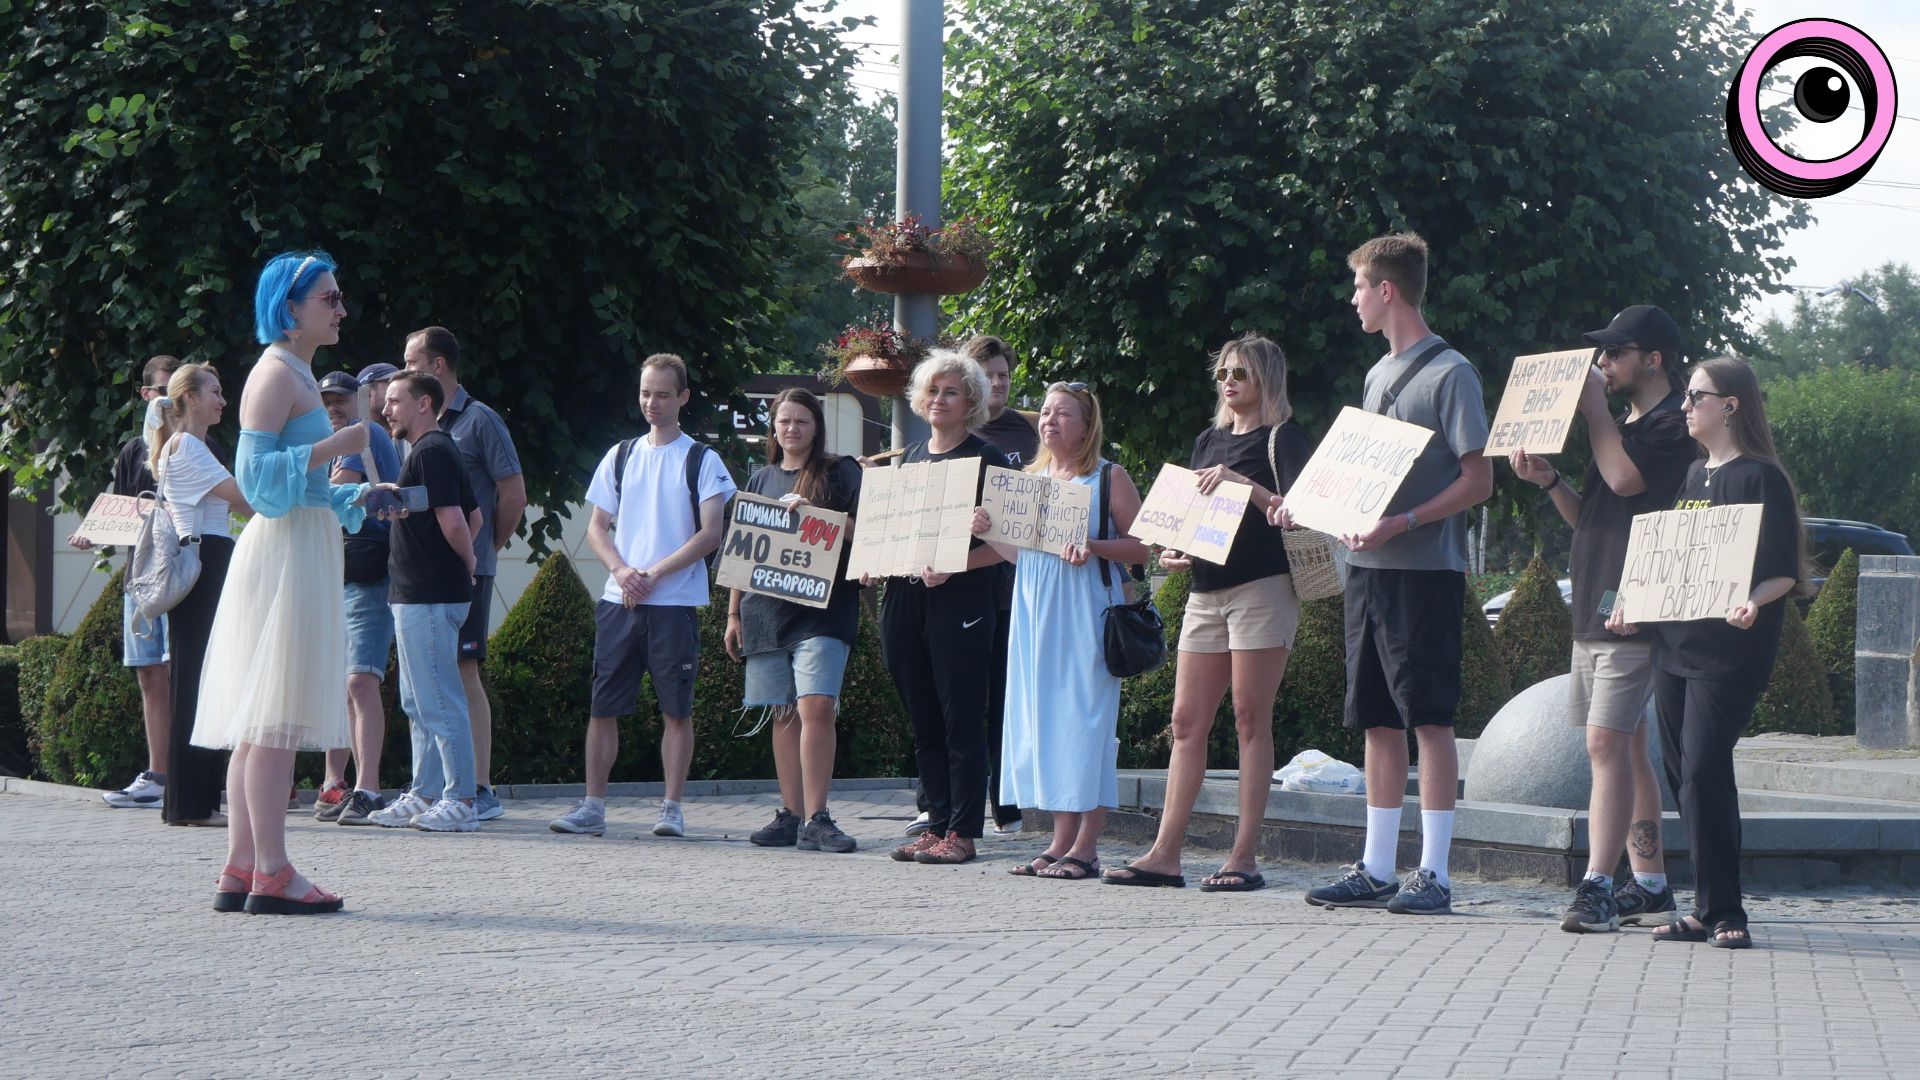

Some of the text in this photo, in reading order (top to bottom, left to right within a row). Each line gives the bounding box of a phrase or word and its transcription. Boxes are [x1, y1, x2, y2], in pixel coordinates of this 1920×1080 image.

[1522, 384, 1563, 415] ВІЙНУ
[990, 472, 1060, 500] ФЕДОРОВ
[736, 501, 791, 529] ПОМИЛКА
[1002, 499, 1028, 516] НАШ
[1039, 501, 1088, 523] МІНІСТР
[1636, 507, 1744, 551] ТАКІ РІШЕННЯ
[725, 529, 812, 568] МО БЕЗ
[1626, 545, 1712, 589] ДОПОМОГА
[753, 568, 826, 598] ФЕДОРОВА
